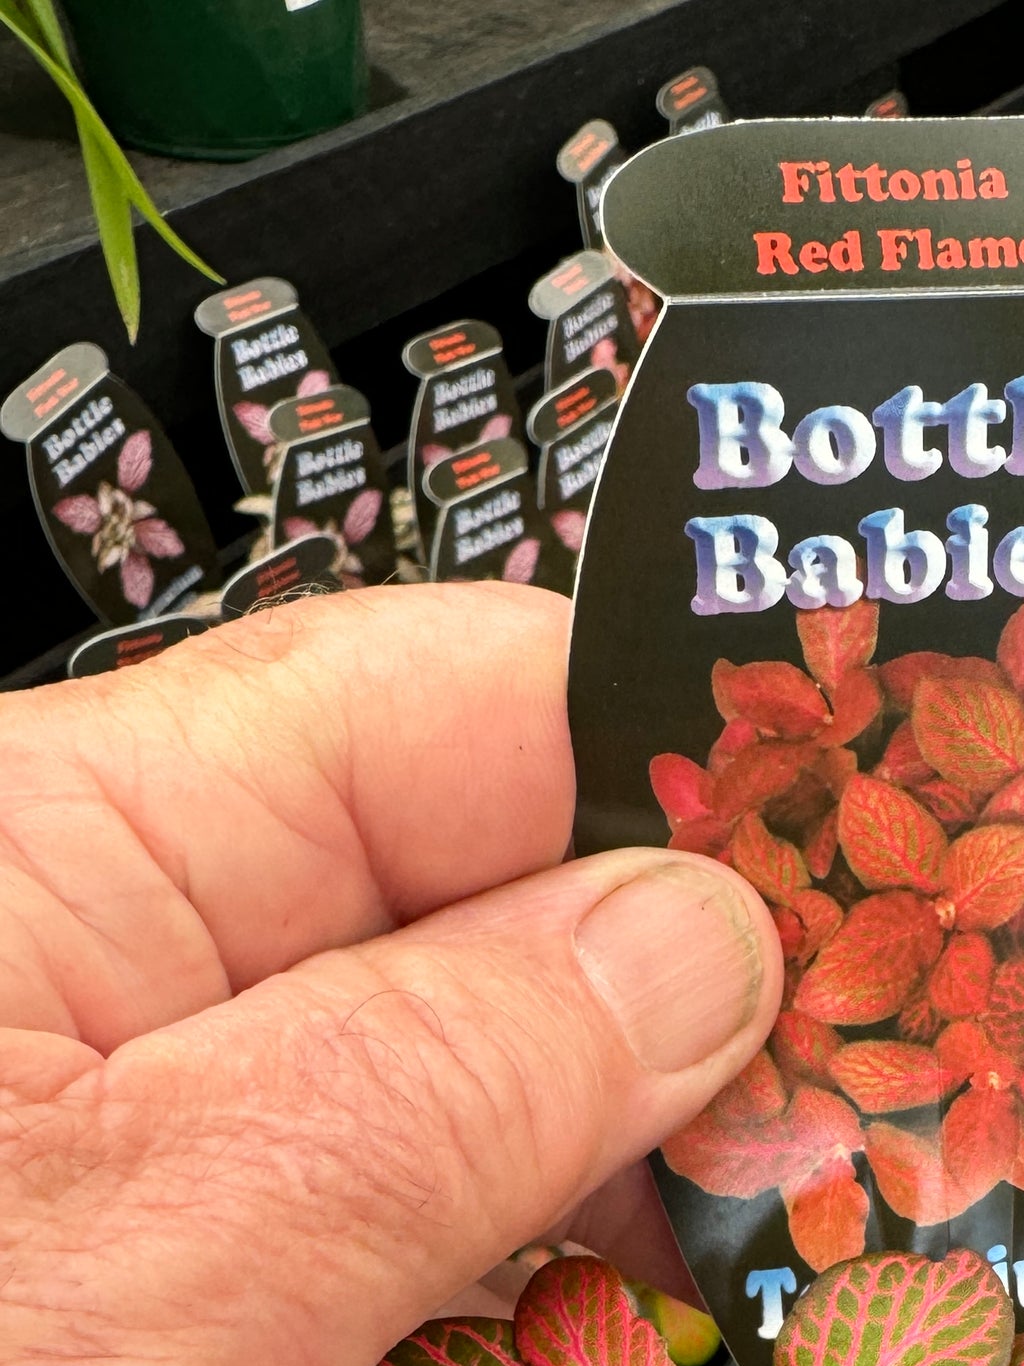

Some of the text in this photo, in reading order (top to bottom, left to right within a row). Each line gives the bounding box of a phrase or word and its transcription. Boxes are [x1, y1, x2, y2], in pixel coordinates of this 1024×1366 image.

[777, 158, 1009, 204] Fittonia
[753, 228, 865, 276] Red
[41, 396, 114, 464] Bottle
[51, 417, 126, 488] Babies
